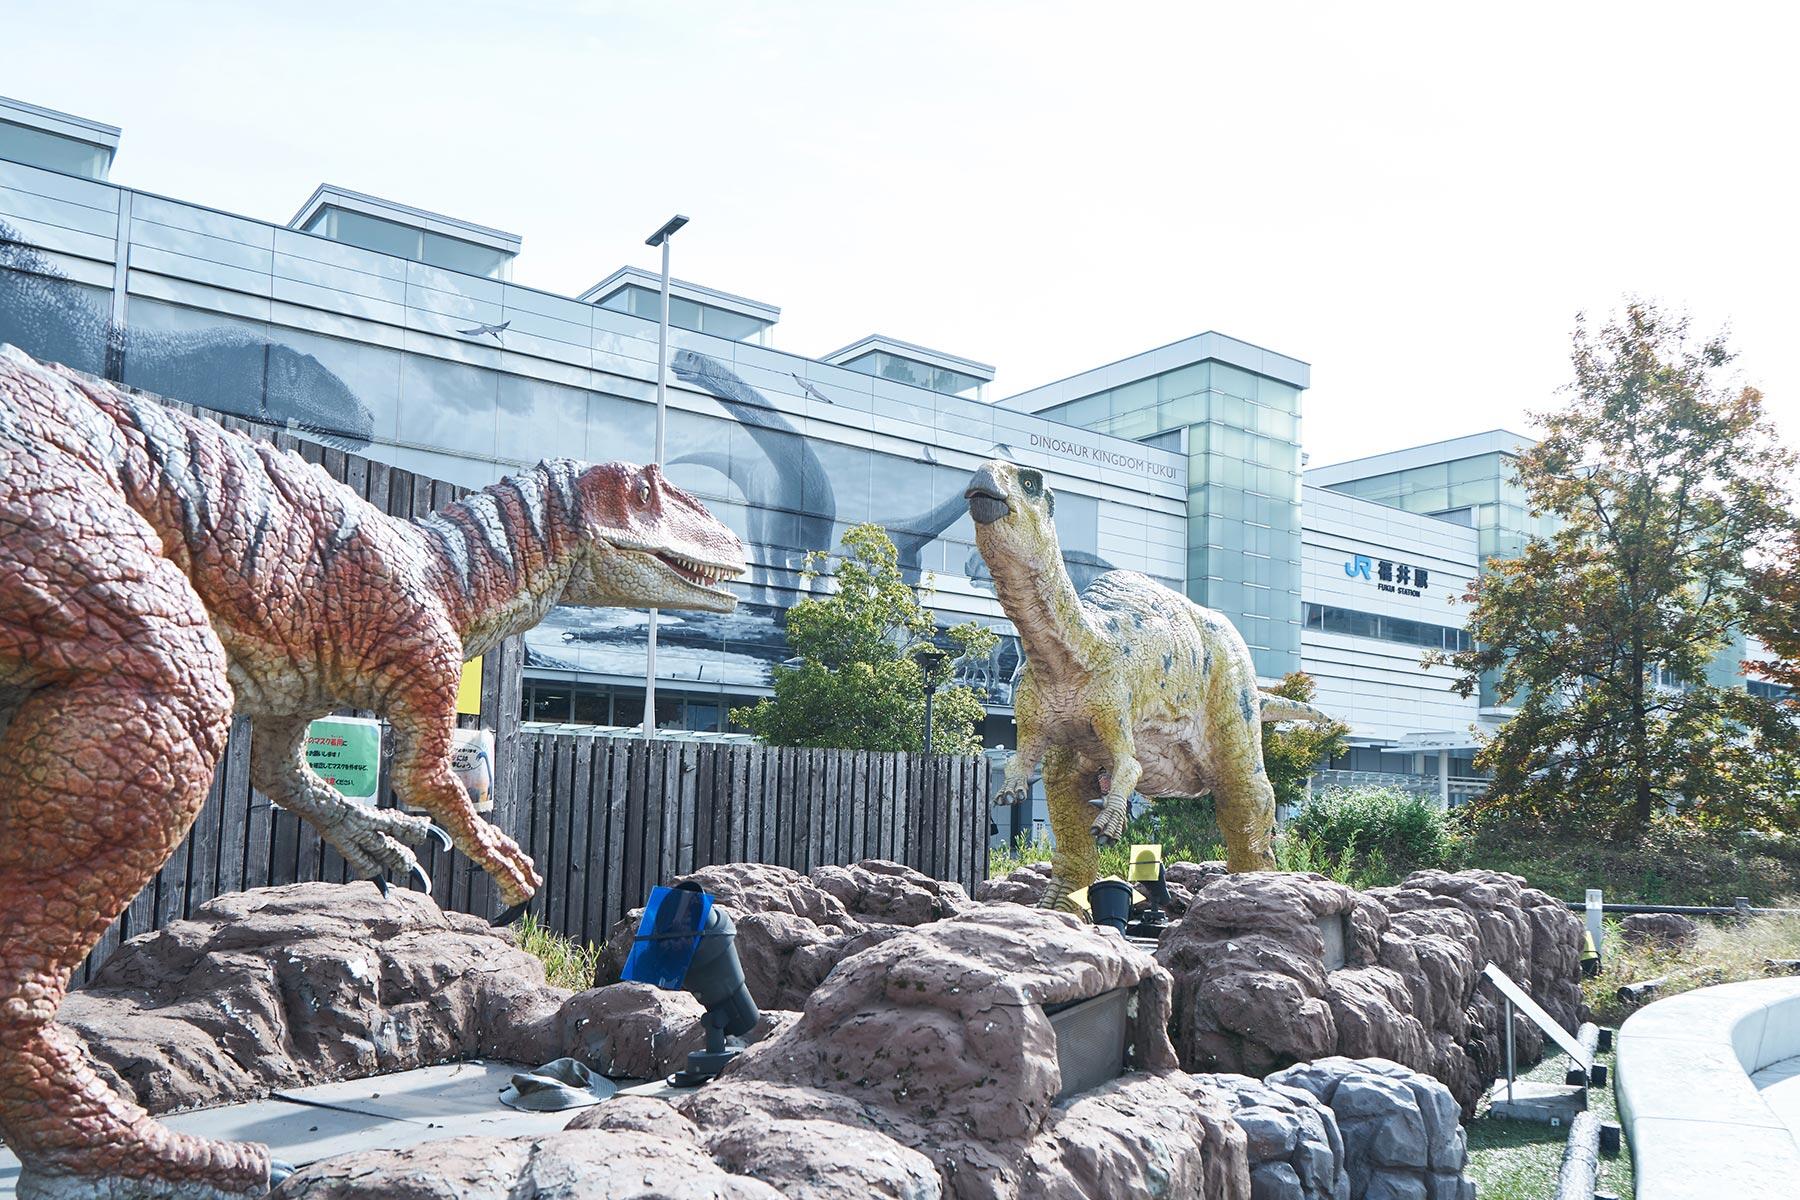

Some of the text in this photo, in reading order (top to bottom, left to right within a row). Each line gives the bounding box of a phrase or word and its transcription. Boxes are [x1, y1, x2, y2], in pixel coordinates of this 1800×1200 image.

[1030, 434, 1177, 479] DINOSAUR KINGDOM FUKUI
[1345, 553, 1428, 589] JR 福井駅
[1397, 587, 1421, 598] STATION
